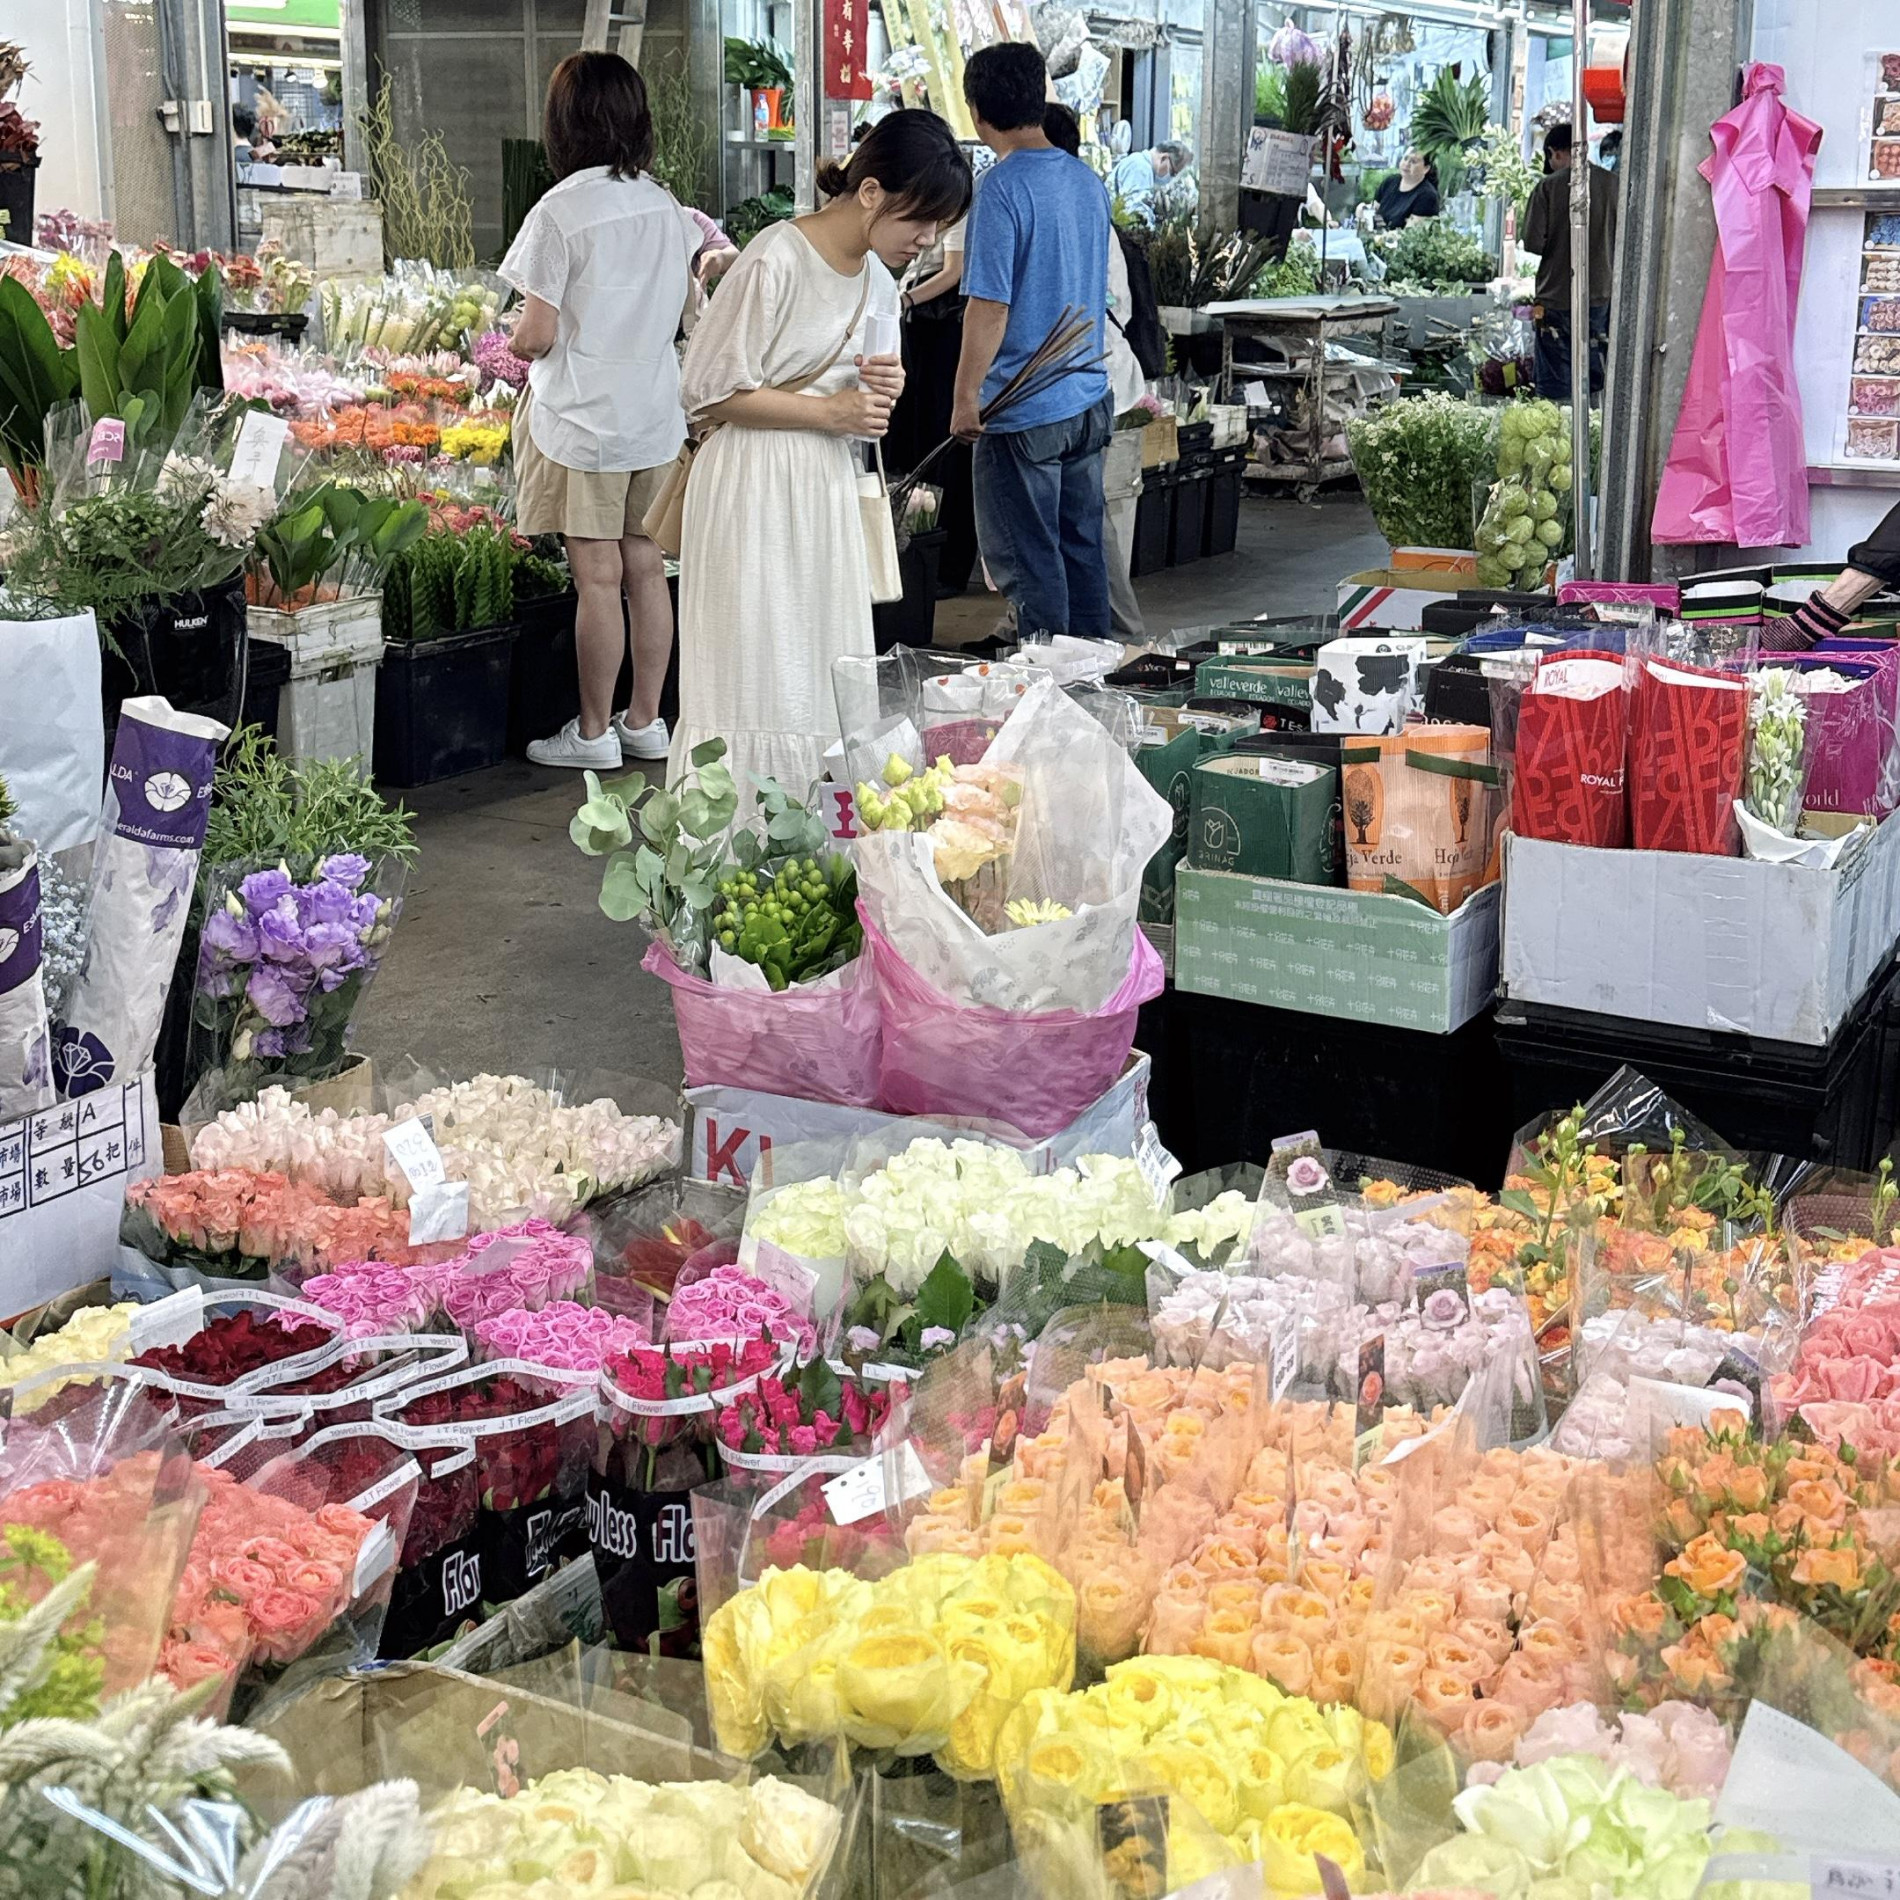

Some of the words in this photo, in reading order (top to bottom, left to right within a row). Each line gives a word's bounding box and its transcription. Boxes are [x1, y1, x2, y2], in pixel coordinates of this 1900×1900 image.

[174, 616, 208, 630] HULKEN
[1210, 677, 1268, 694] valleverde
[1580, 773, 1616, 788] ROYAL
[1361, 849, 1402, 865] Verde
[82, 1103, 96, 1124] A
[34, 1156, 76, 1190] 數量
[106, 1142, 121, 1161] 把
[423, 1359, 450, 1372] Flower
[185, 1384, 216, 1396] Flower
[631, 1401, 664, 1414] Flower
[517, 1411, 548, 1426] Flower
[453, 1424, 487, 1436] Flower
[217, 1438, 242, 1461] Flower
[730, 1453, 761, 1467] Flower
[376, 1475, 402, 1498] Flower
